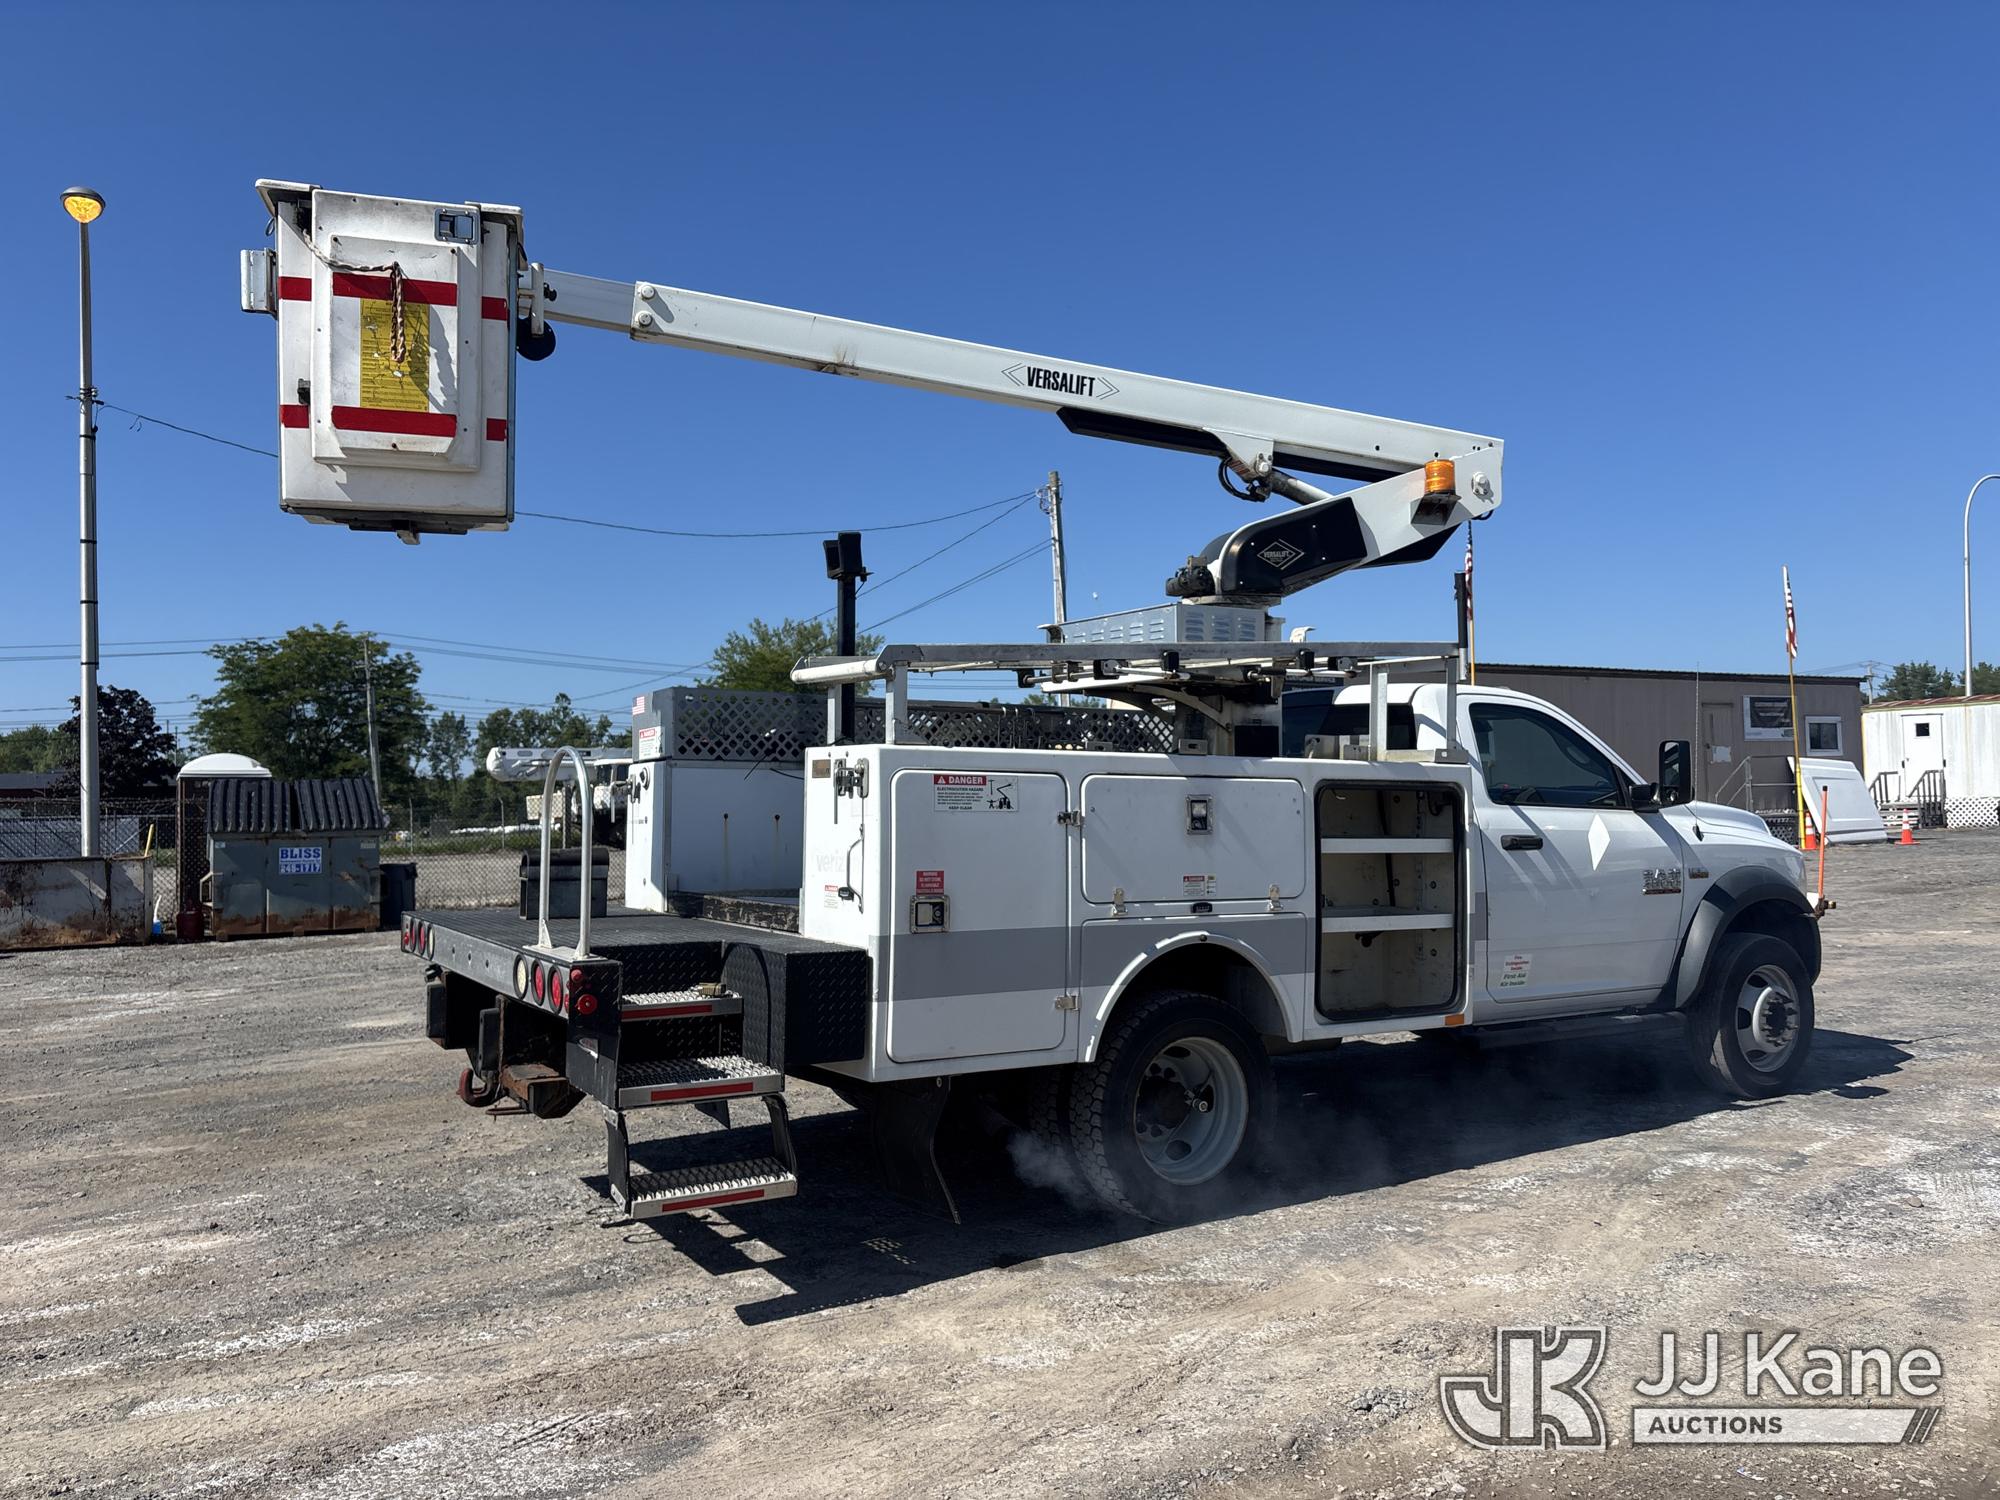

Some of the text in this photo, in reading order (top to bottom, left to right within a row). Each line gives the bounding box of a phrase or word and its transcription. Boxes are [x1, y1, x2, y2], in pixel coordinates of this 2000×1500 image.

[1027, 366, 1096, 397] VERSALIFT
[948, 776, 984, 785] DANGER
[280, 848, 321, 859] BLISS
